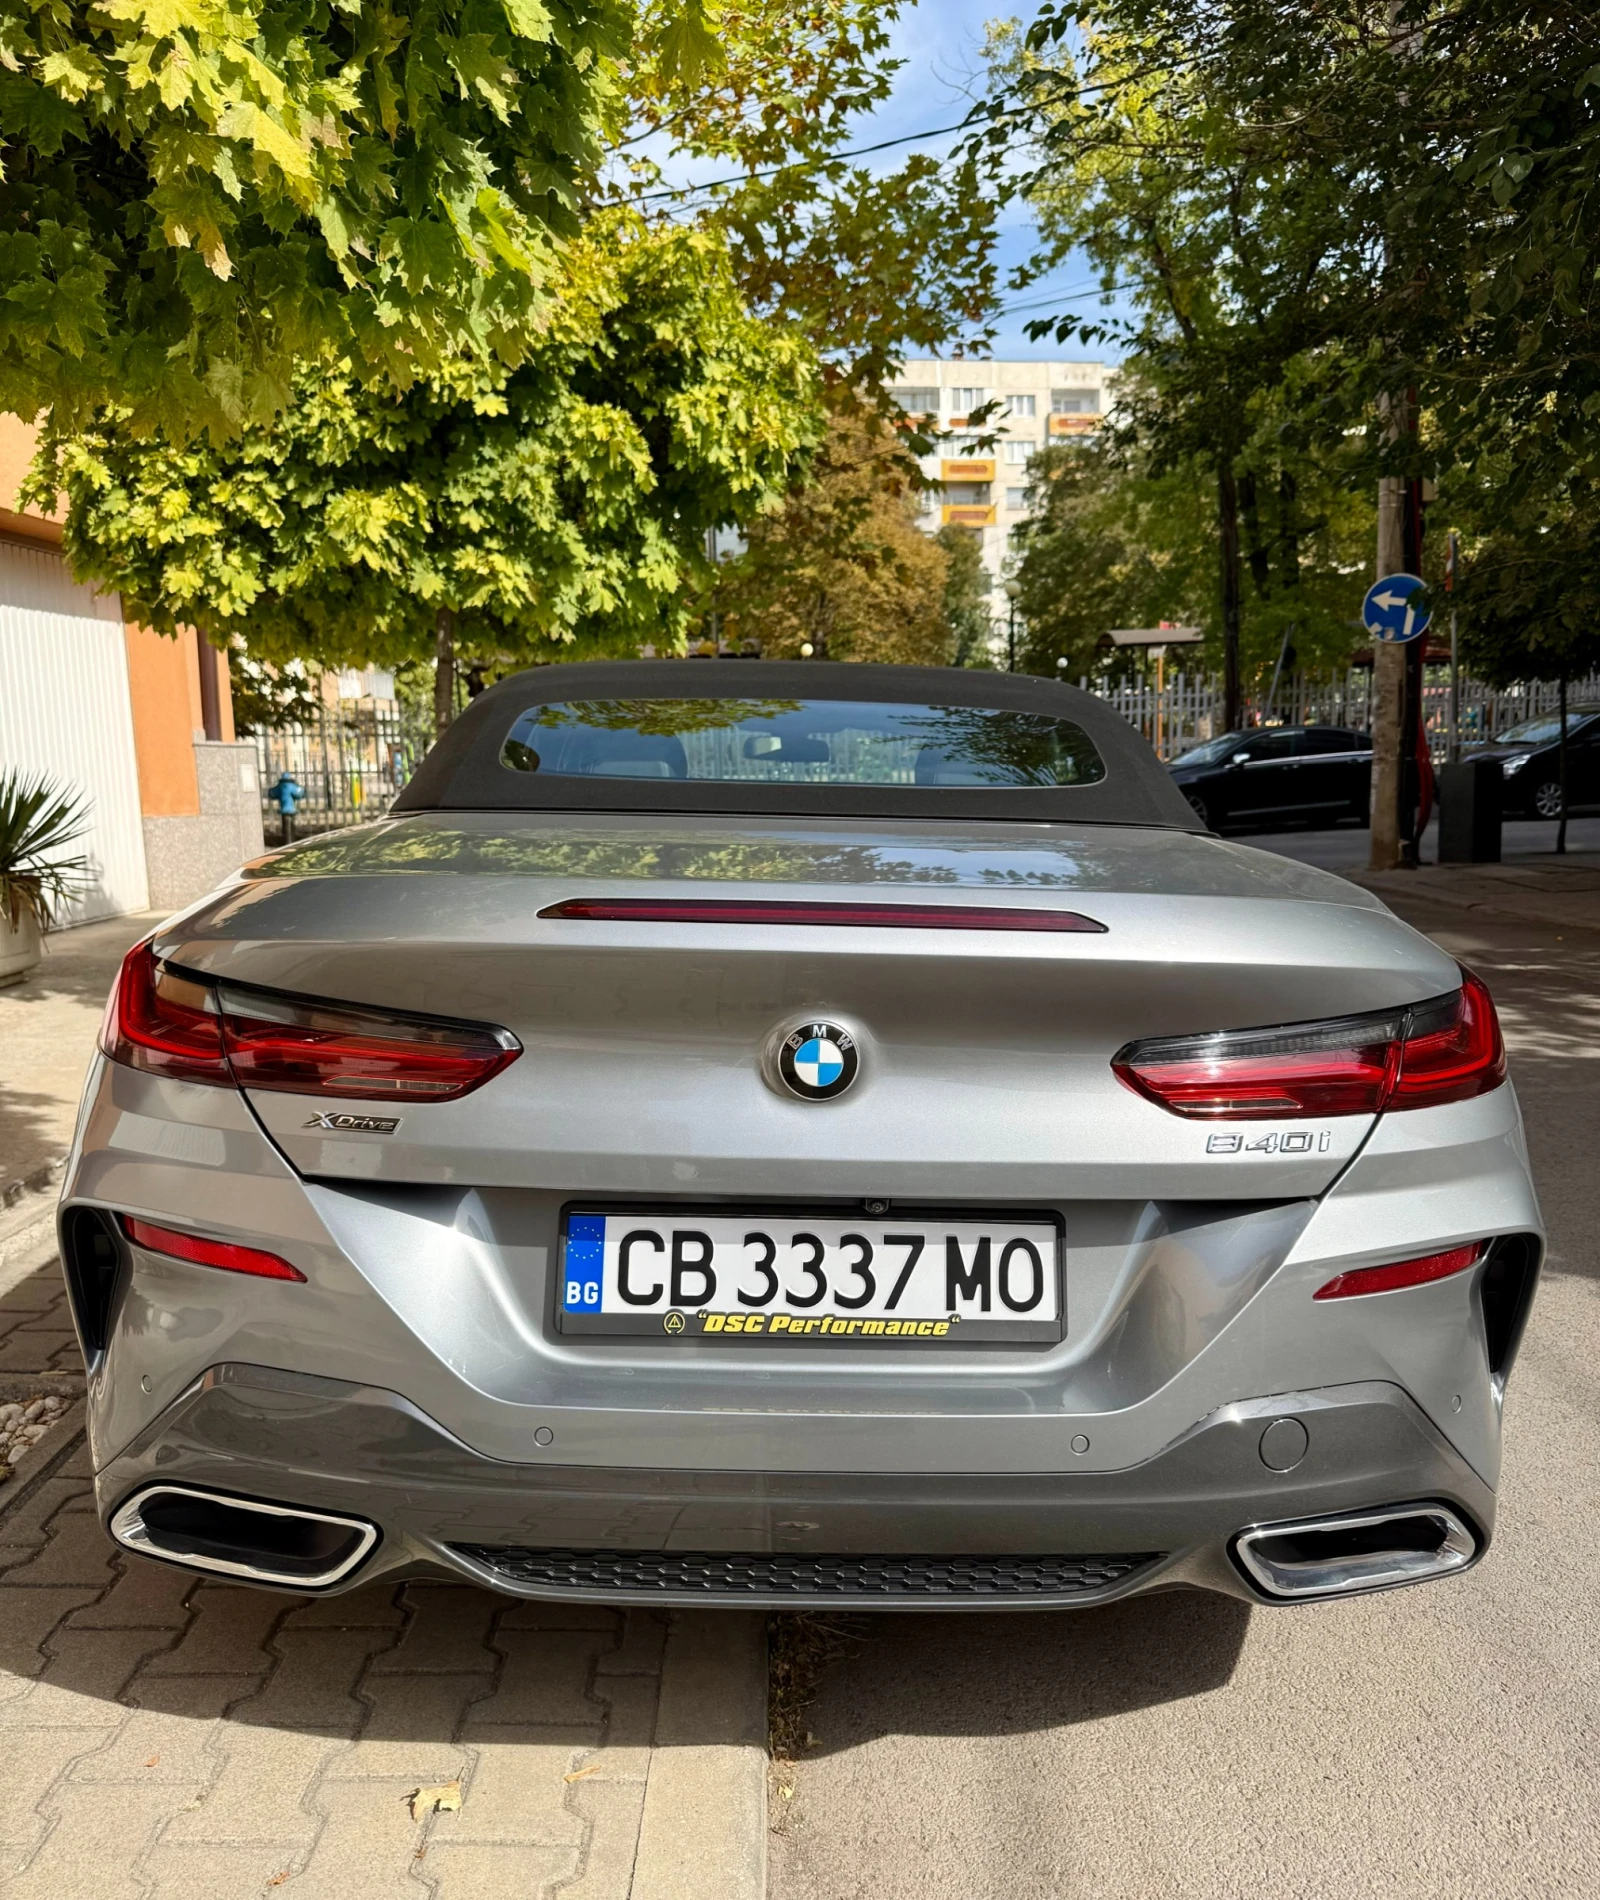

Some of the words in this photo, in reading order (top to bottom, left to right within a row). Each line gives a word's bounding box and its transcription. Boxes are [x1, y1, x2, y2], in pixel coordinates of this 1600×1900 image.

[787, 1024, 854, 1051] BMW
[1206, 1130, 1331, 1153] 840i
[616, 1229, 717, 1307] CB
[737, 1232, 926, 1310] 3337
[945, 1235, 1045, 1313] MO
[566, 1280, 599, 1305] BG
